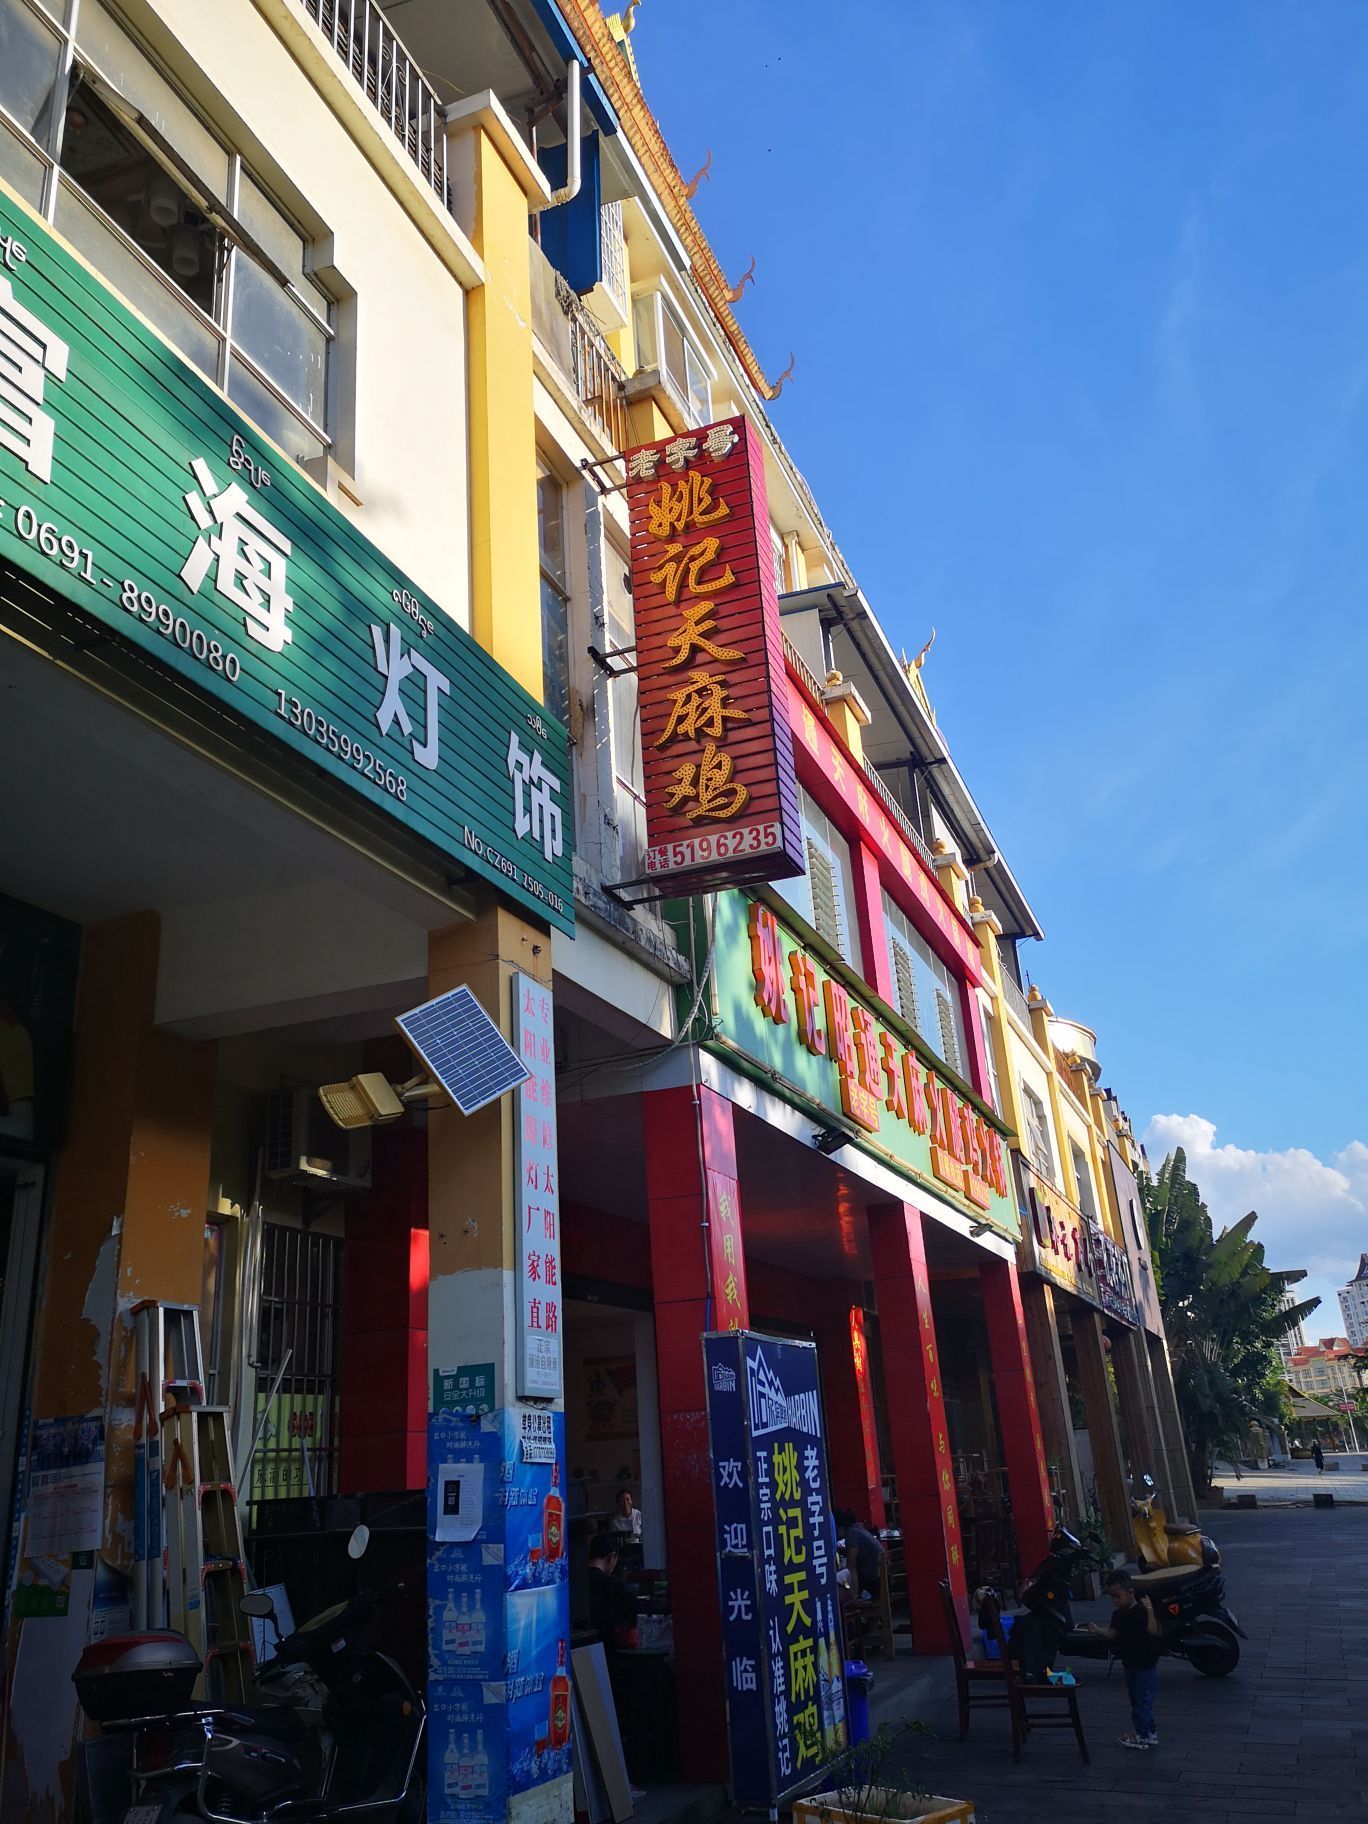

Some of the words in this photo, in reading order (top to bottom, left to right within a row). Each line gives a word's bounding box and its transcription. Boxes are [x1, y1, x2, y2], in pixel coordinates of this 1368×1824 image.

[629, 424, 739, 480] 老字号
[15, 504, 241, 683] 0691-8990080
[648, 470, 750, 821] 姚记天麻鸡
[275, 688, 407, 801] 13035992568
[672, 823, 778, 867] 5196235
[849, 1081, 878, 1128] 老字号
[443, 1387, 486, 1401] 安全大升级
[786, 1389, 821, 1438] HARBIN
[717, 1457, 758, 1692] 欢迎光临
[756, 1451, 779, 1599] 正宗口味
[803, 1444, 828, 1586] 老字号
[772, 1442, 823, 1772] 姚记天麻鸡
[768, 1615, 792, 1779] 认准姚记
